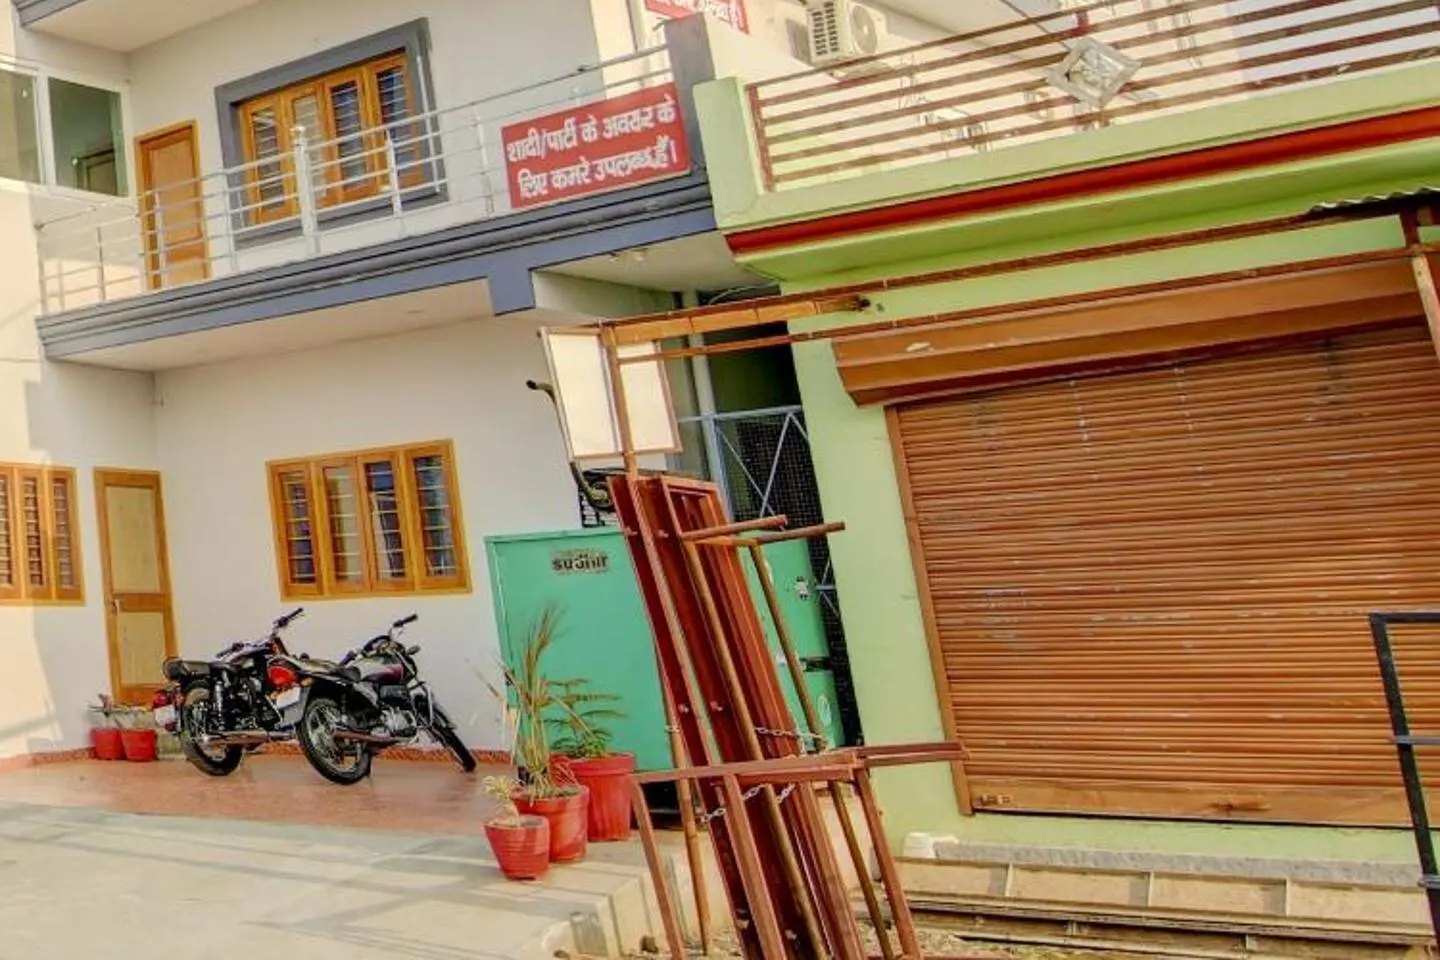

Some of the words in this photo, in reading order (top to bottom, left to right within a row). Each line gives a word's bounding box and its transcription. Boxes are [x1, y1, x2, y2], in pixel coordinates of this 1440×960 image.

[507, 117, 578, 162] शादी/पार्टी
[580, 114, 599, 144] के
[602, 106, 655, 139] अवसर
[655, 92, 676, 124] के
[517, 168, 548, 198] लिए
[550, 156, 590, 189] कमरे
